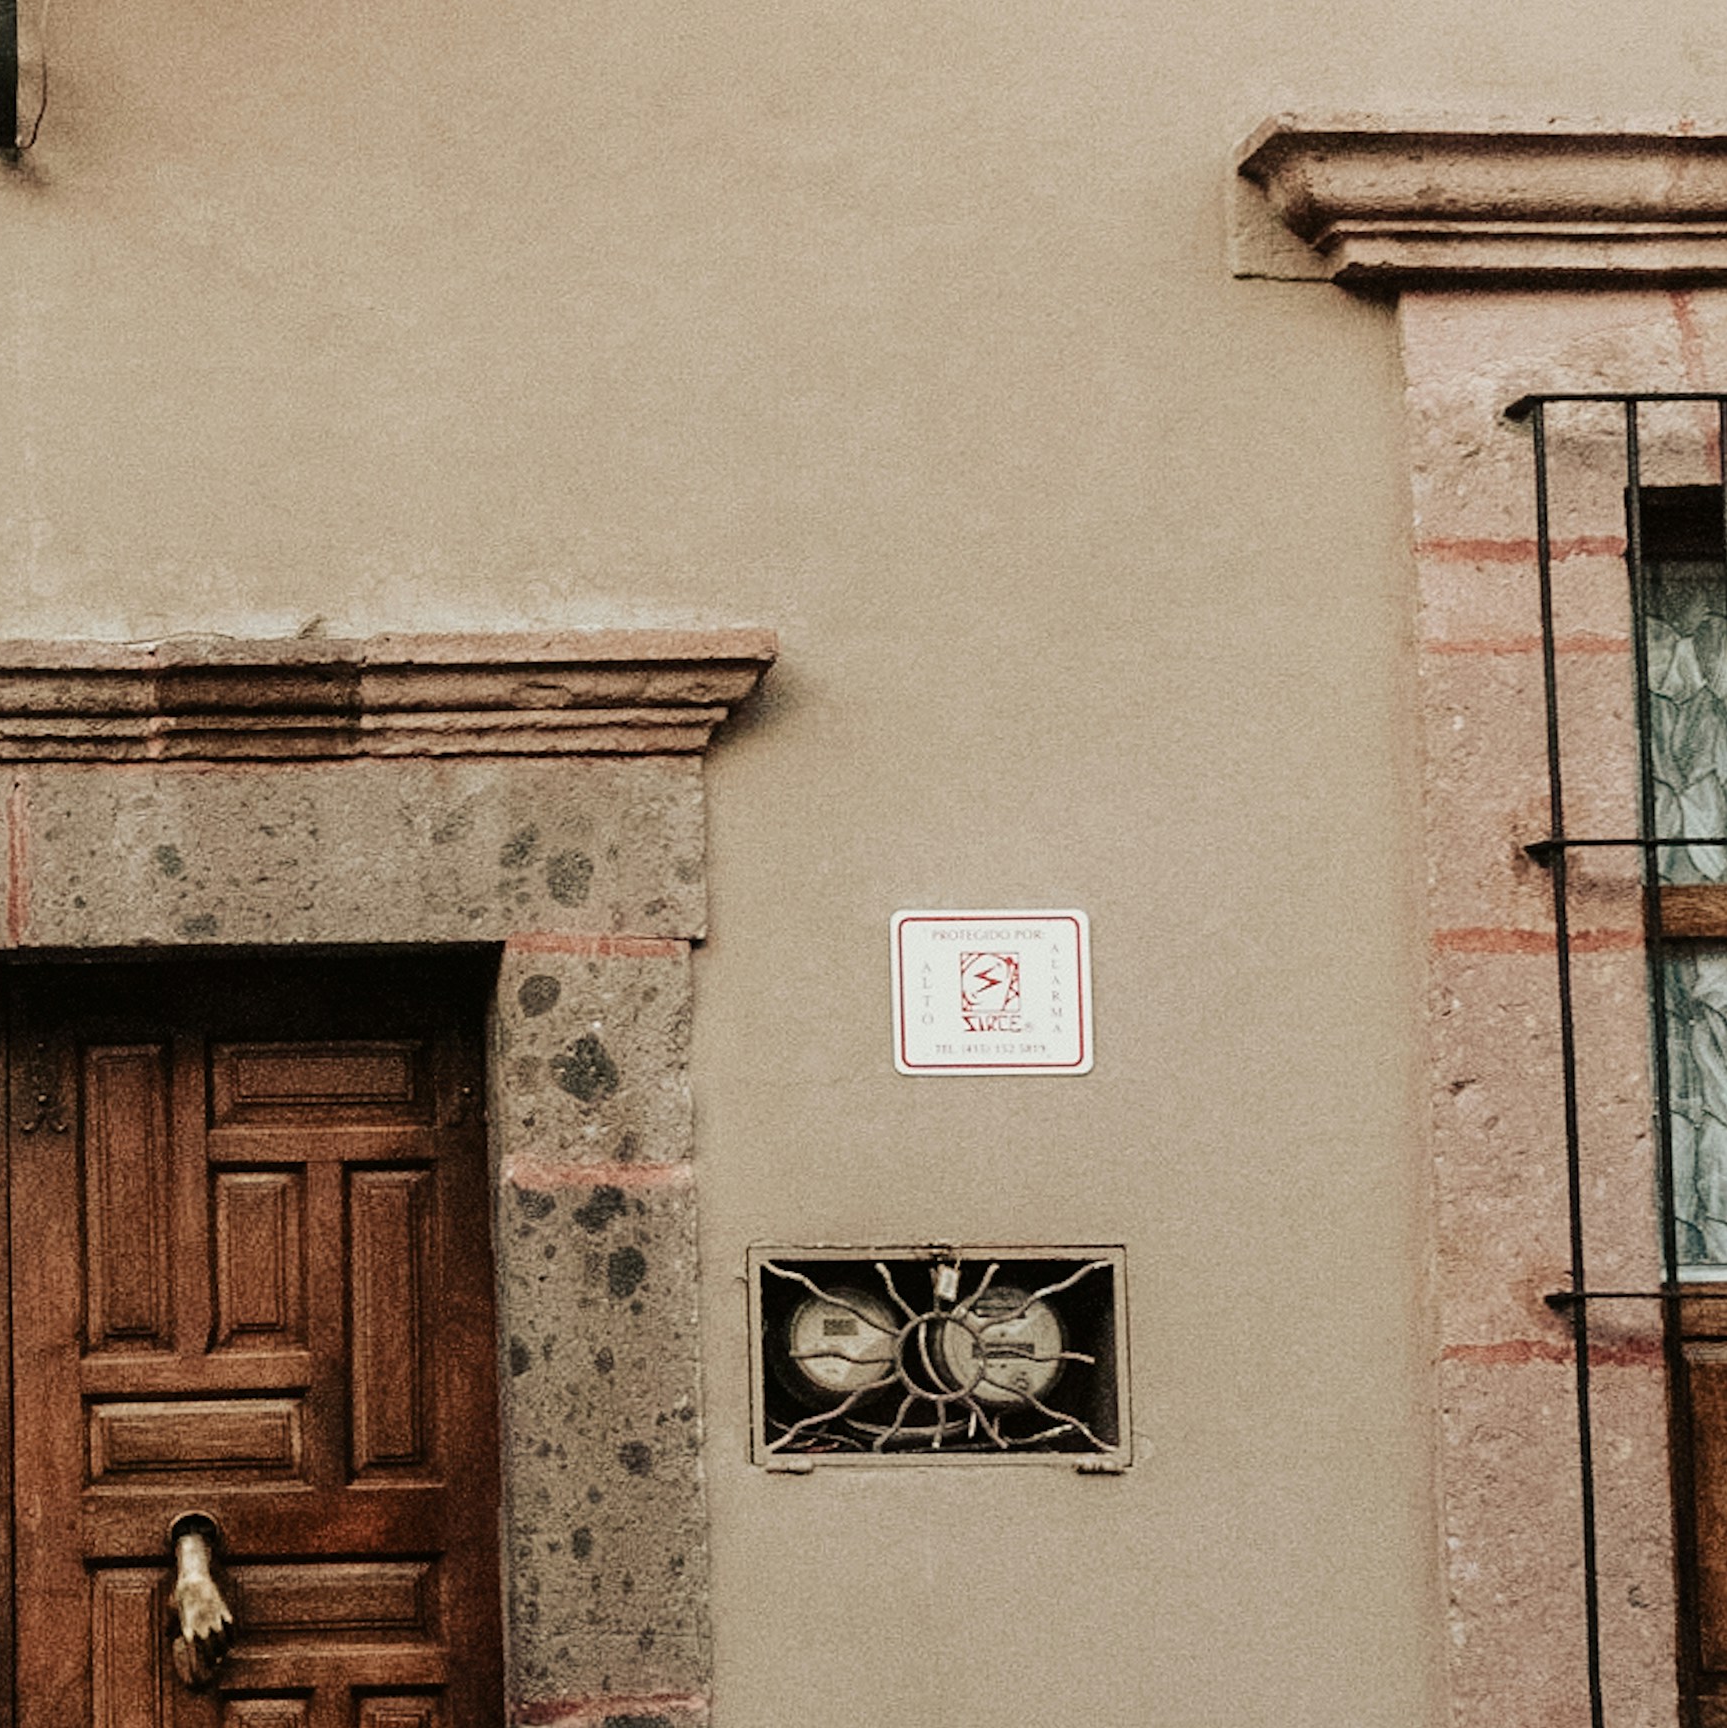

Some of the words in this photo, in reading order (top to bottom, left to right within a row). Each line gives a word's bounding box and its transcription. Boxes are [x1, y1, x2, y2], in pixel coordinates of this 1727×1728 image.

[932, 930, 1010, 941] PROTEGIDO
[922, 962, 934, 1025] ALTO
[1051, 944, 1063, 1032] ALARMA
